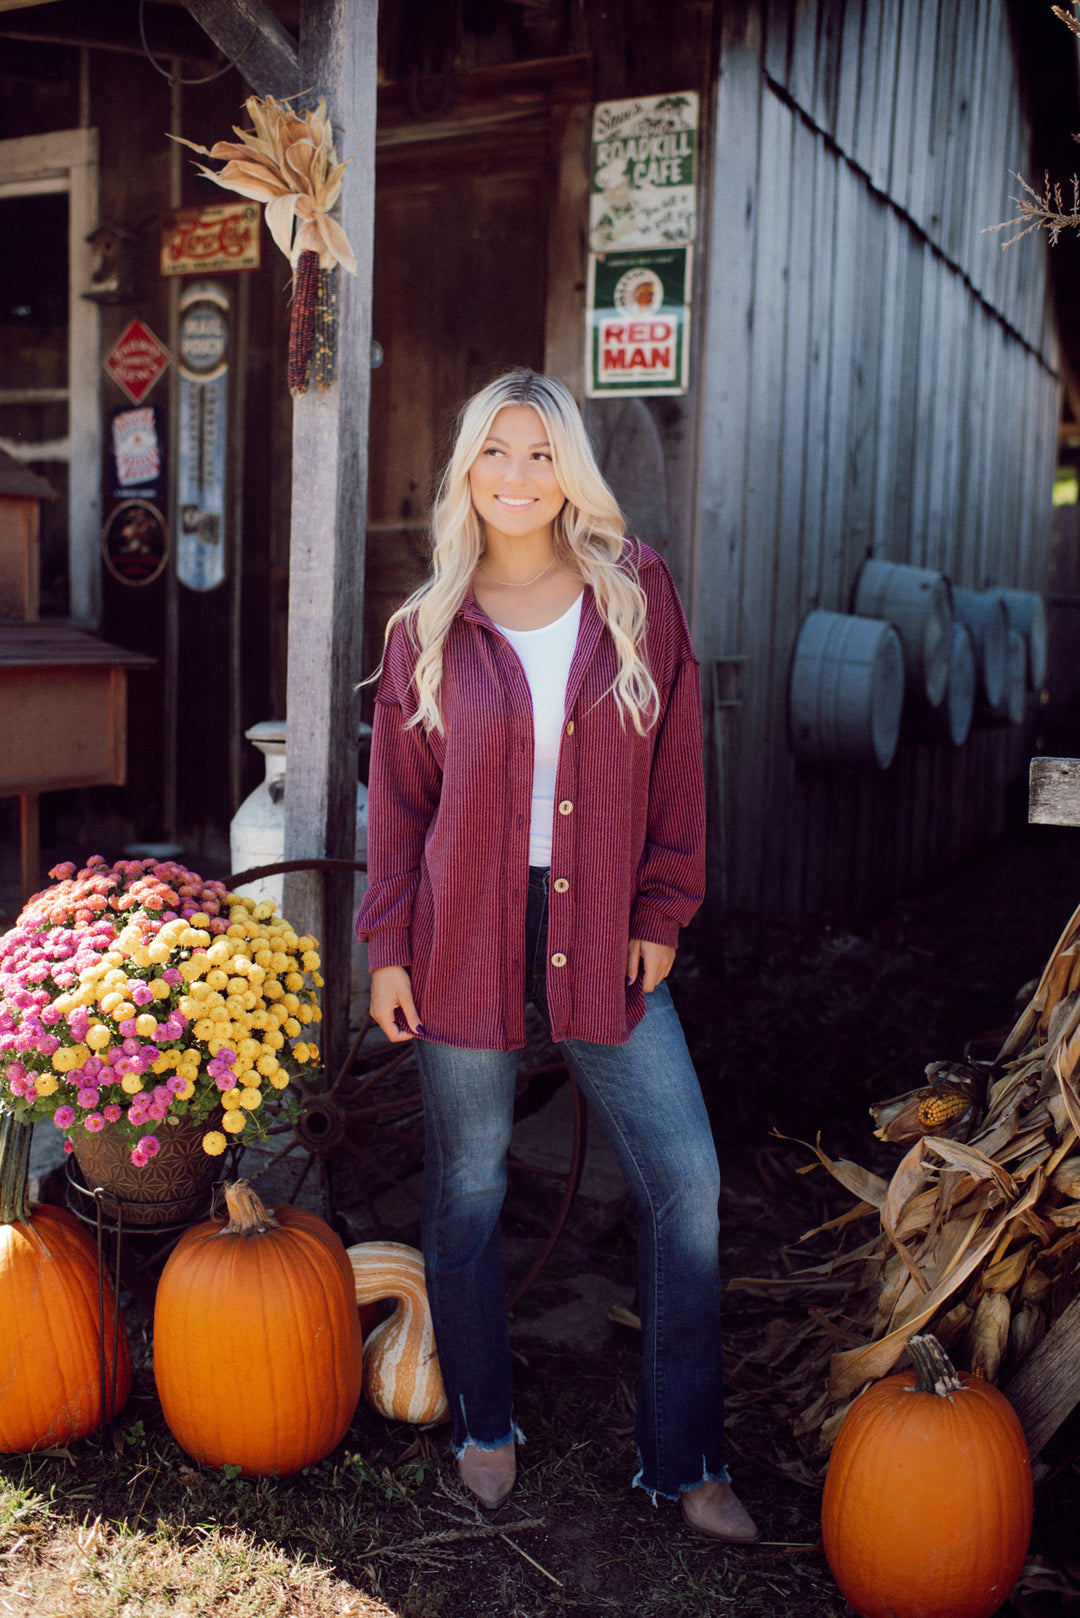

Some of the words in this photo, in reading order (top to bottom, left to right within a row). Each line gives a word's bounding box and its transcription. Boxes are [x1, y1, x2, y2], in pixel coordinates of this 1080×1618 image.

[597, 133, 693, 167] ROADKILL
[633, 158, 683, 187] CAFE
[605, 322, 671, 344] RED
[604, 347, 669, 370] MAN
